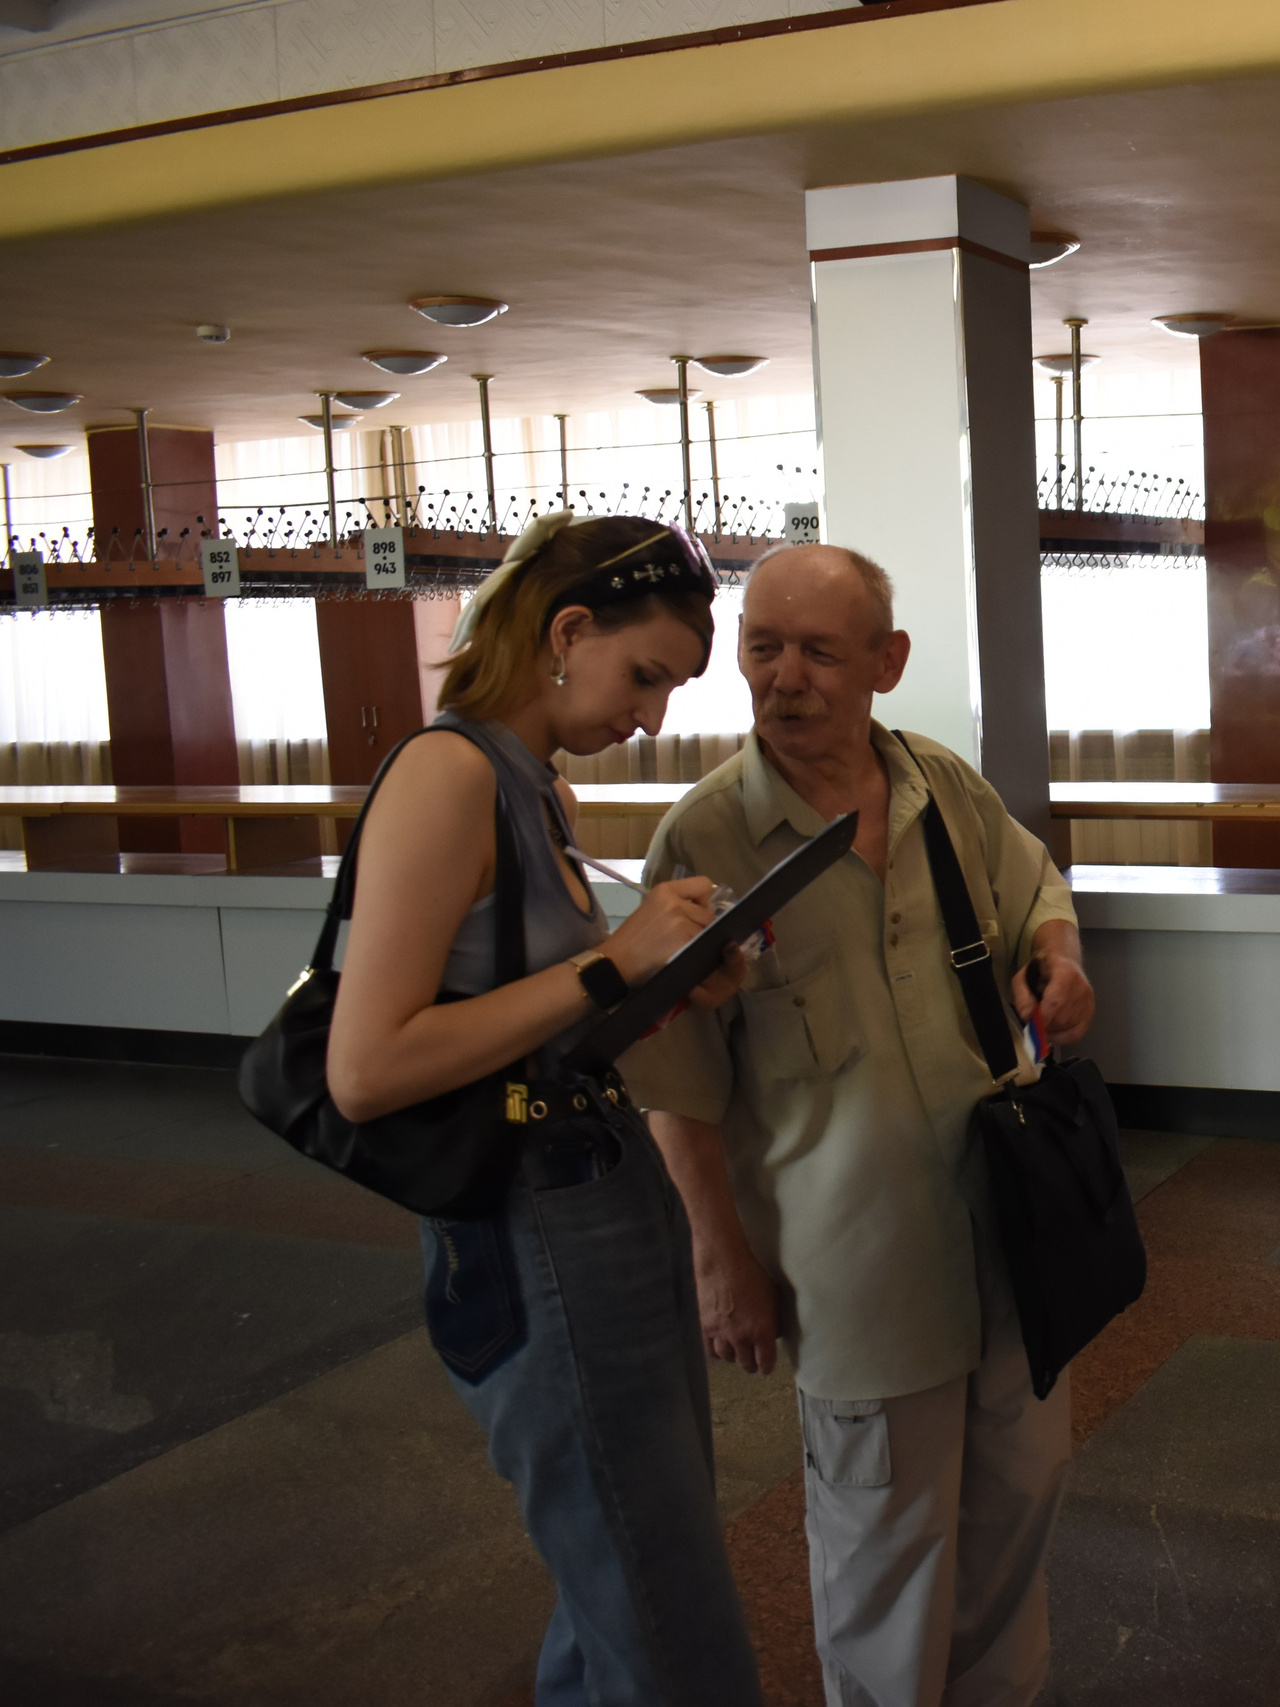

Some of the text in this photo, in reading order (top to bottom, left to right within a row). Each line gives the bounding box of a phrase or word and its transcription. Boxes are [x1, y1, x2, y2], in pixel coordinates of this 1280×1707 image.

[791, 516, 819, 530] 990
[373, 541, 396, 555] 898
[210, 551, 231, 564] 852
[374, 562, 397, 575] 943
[211, 571, 232, 584] 897
